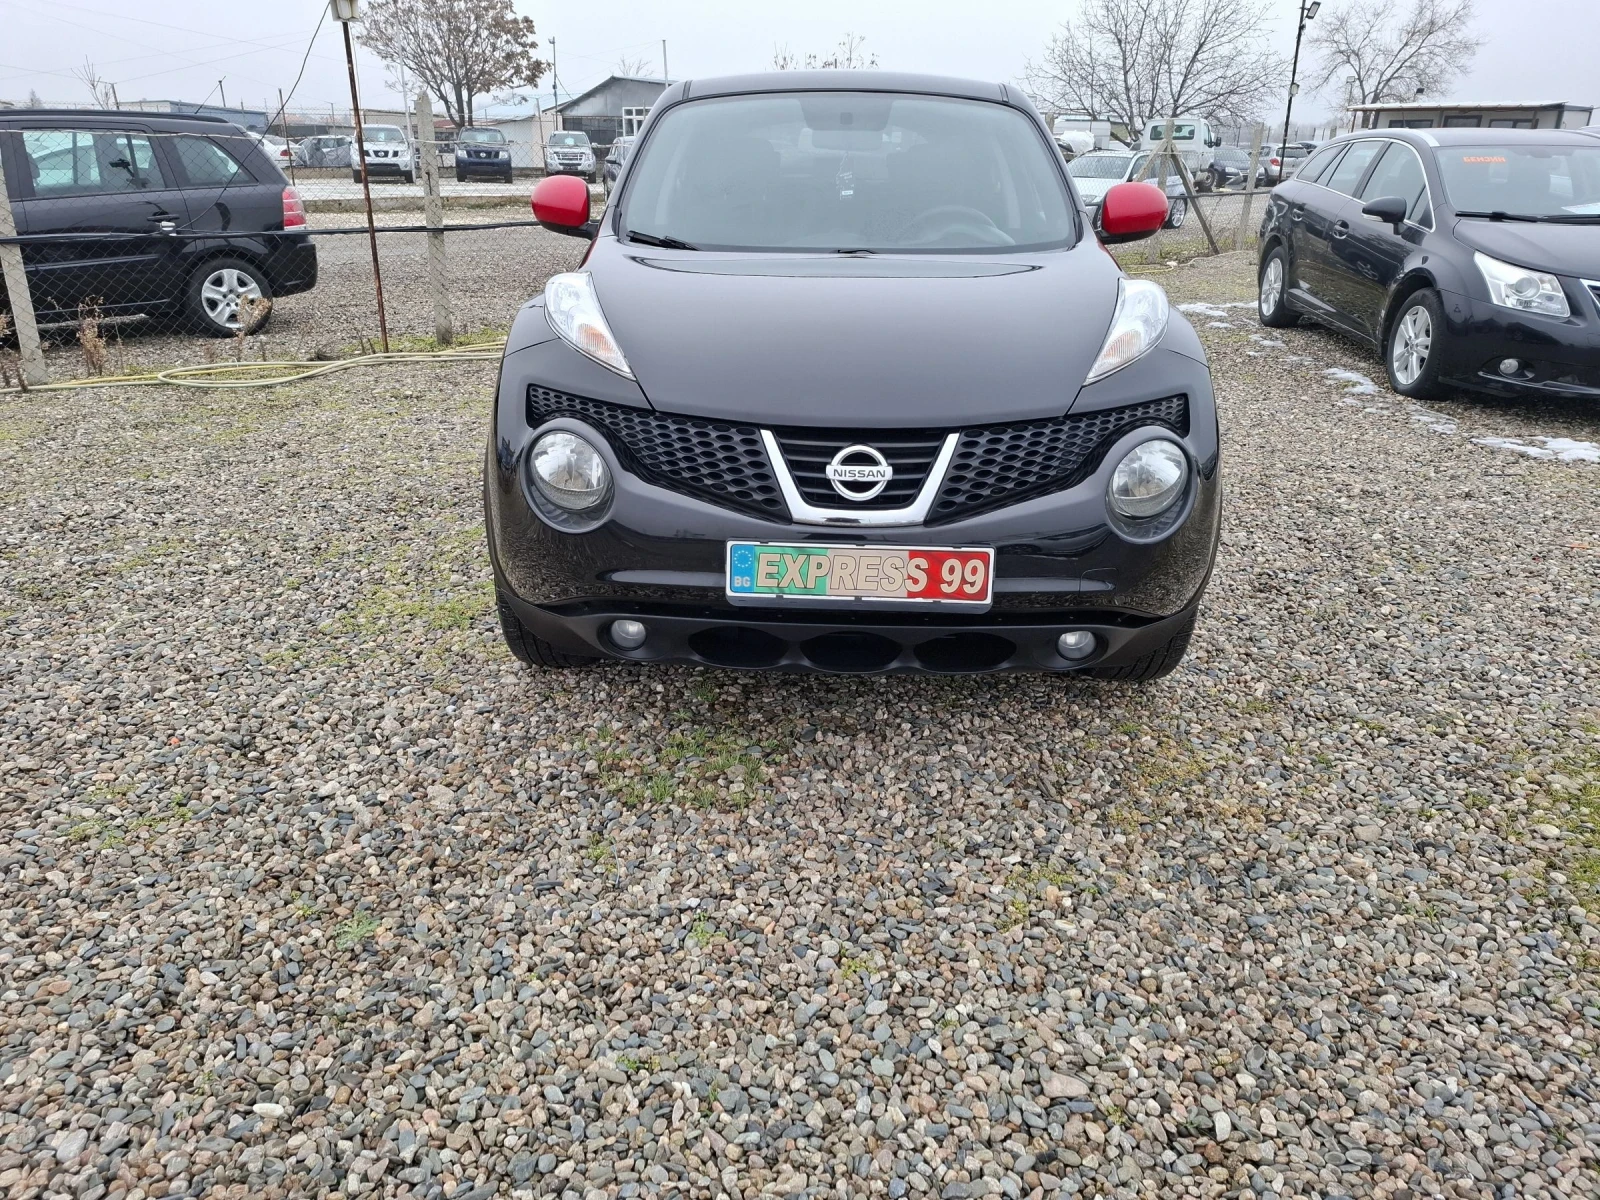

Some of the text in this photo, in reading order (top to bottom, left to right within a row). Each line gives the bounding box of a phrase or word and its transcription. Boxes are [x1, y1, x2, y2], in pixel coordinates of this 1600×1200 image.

[833, 468, 886, 478] NISSAN
[756, 553, 985, 593] EXPRESS 99
[733, 575, 751, 587] BG
